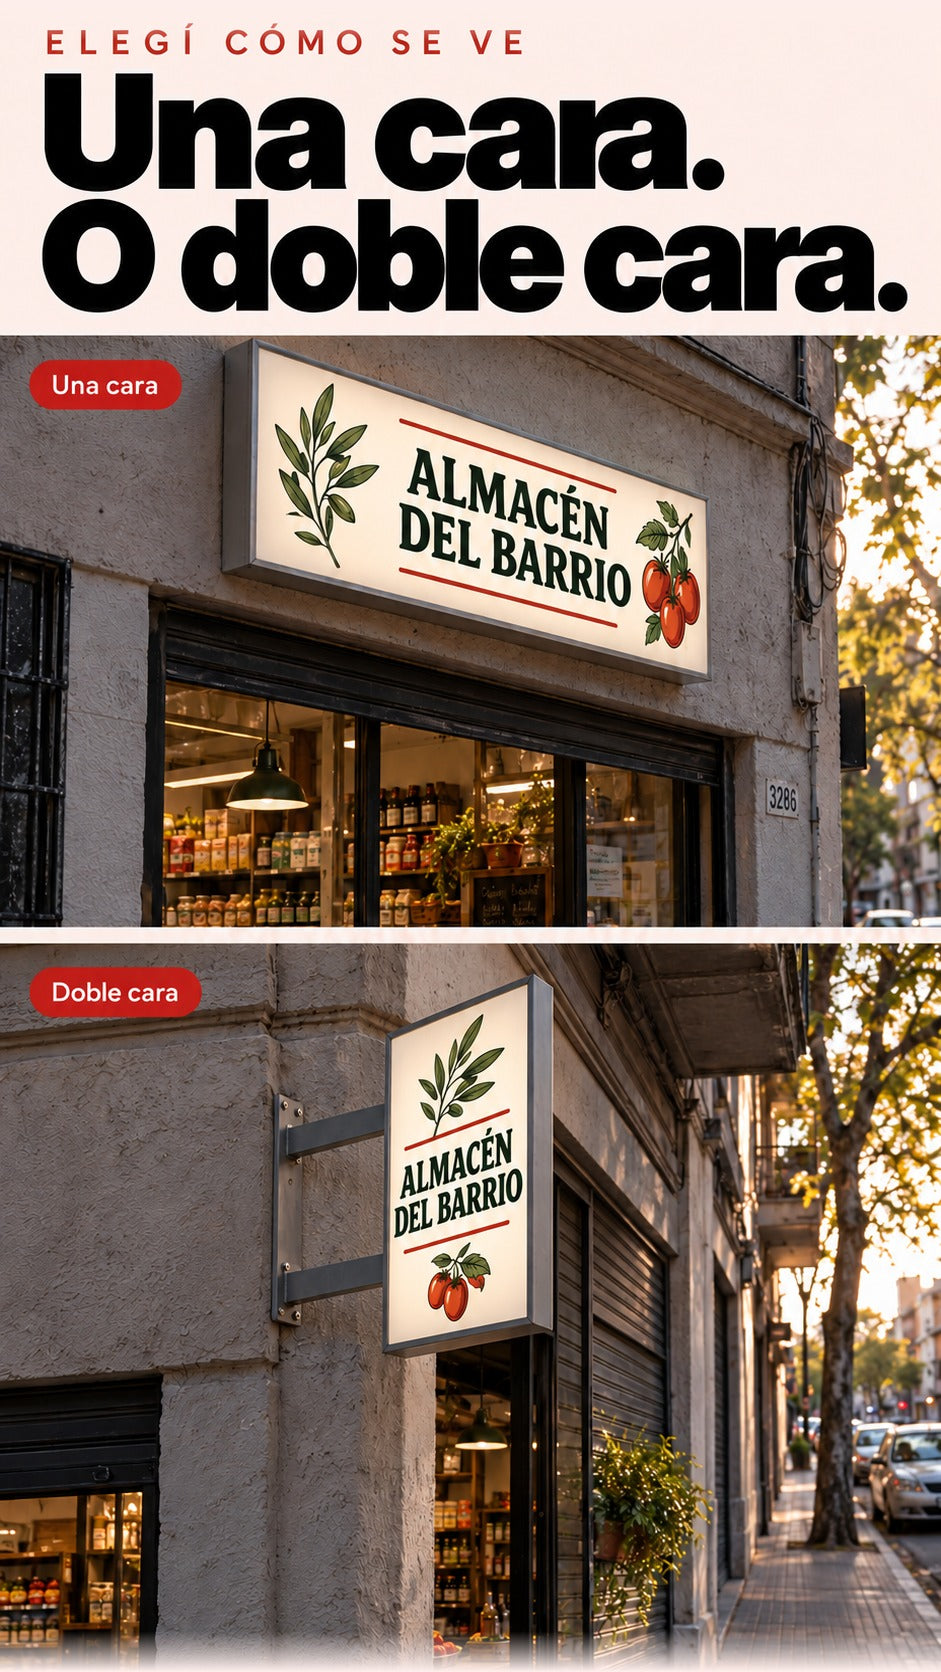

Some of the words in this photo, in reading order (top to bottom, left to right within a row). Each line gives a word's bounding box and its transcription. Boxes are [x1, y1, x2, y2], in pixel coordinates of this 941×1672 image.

[406, 447, 609, 551] ALMACÉN
[398, 502, 482, 570] DEL
[490, 528, 632, 608] BARRIO
[769, 784, 797, 813] 3286
[399, 1127, 513, 1200] ALMACÉN
[393, 1198, 433, 1239] DEL
[436, 1168, 523, 1225] BARRIO
